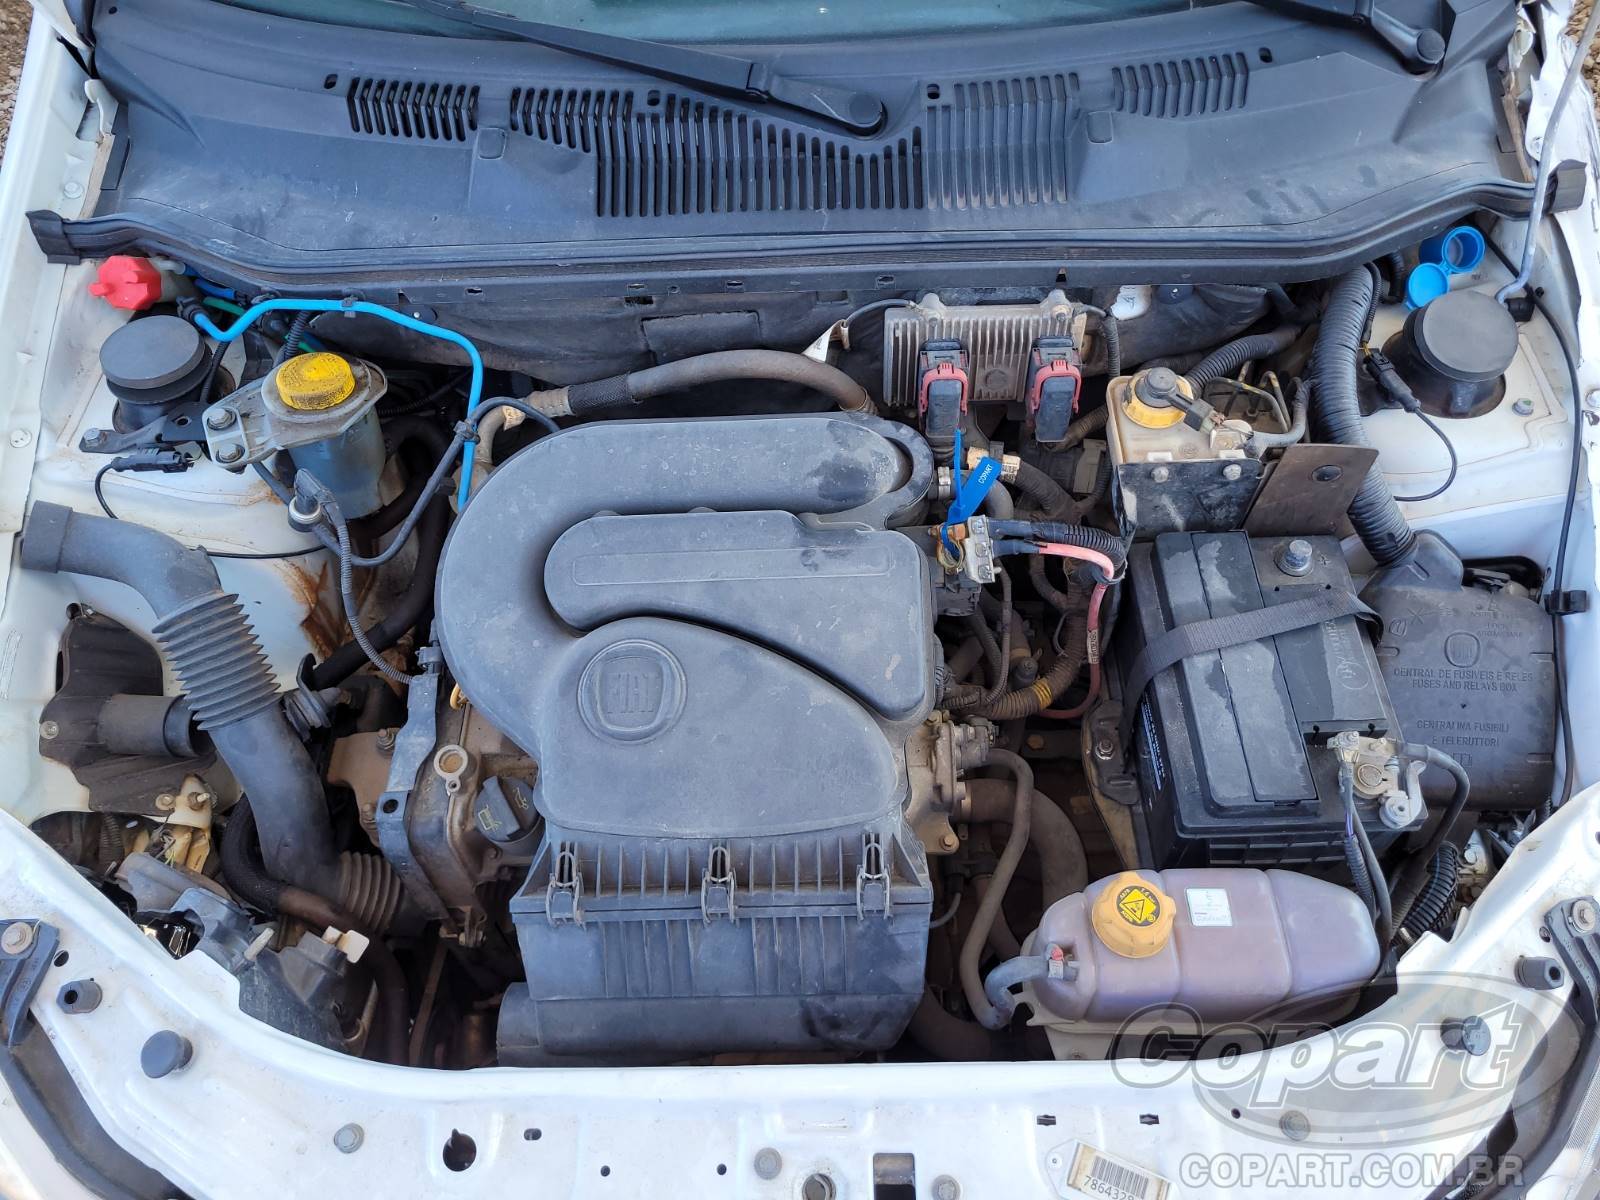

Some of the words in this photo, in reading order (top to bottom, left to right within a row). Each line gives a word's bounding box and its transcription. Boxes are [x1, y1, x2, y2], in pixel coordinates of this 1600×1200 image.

[977, 463, 993, 484] COPART
[1393, 668, 1435, 678] CENTRAL
[1438, 669, 1450, 678] DE
[1412, 680, 1441, 689] FUSES
[1443, 680, 1462, 690] AND
[1463, 681, 1498, 692] RELAYS
